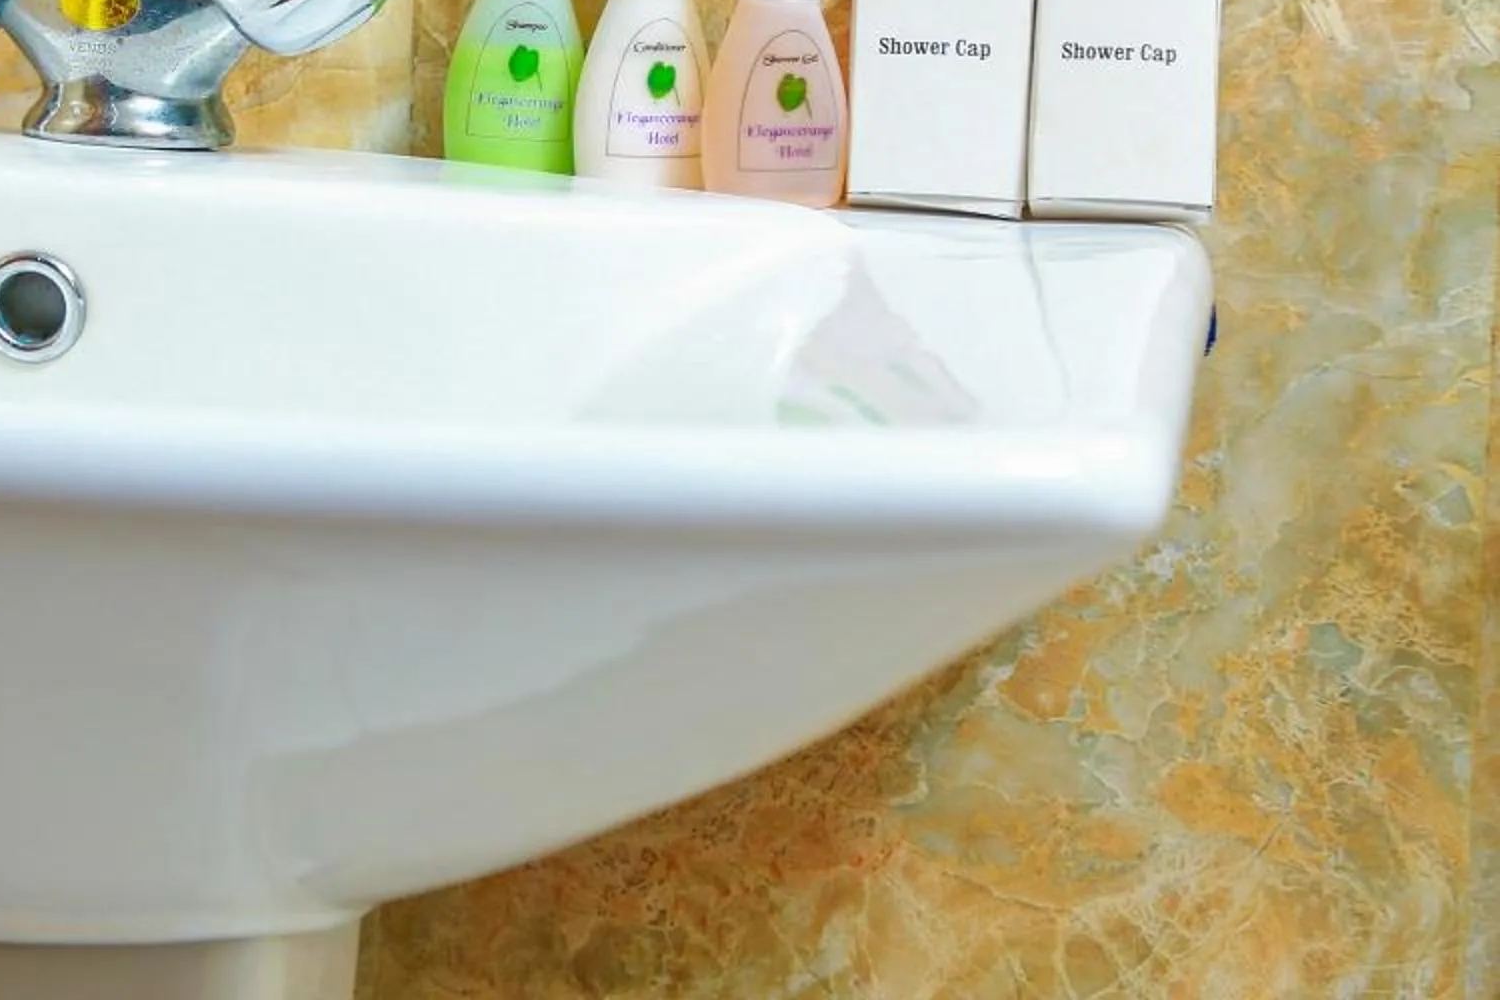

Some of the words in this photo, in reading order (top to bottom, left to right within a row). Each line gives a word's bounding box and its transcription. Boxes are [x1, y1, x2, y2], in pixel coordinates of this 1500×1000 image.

[505, 19, 549, 33] Shampoo
[878, 37, 950, 56] Shower
[955, 39, 992, 61] Cap
[1060, 42, 1135, 62] Shower
[1140, 43, 1178, 66] Cap
[762, 53, 800, 67] Shower
[646, 131, 679, 145] Hotel
